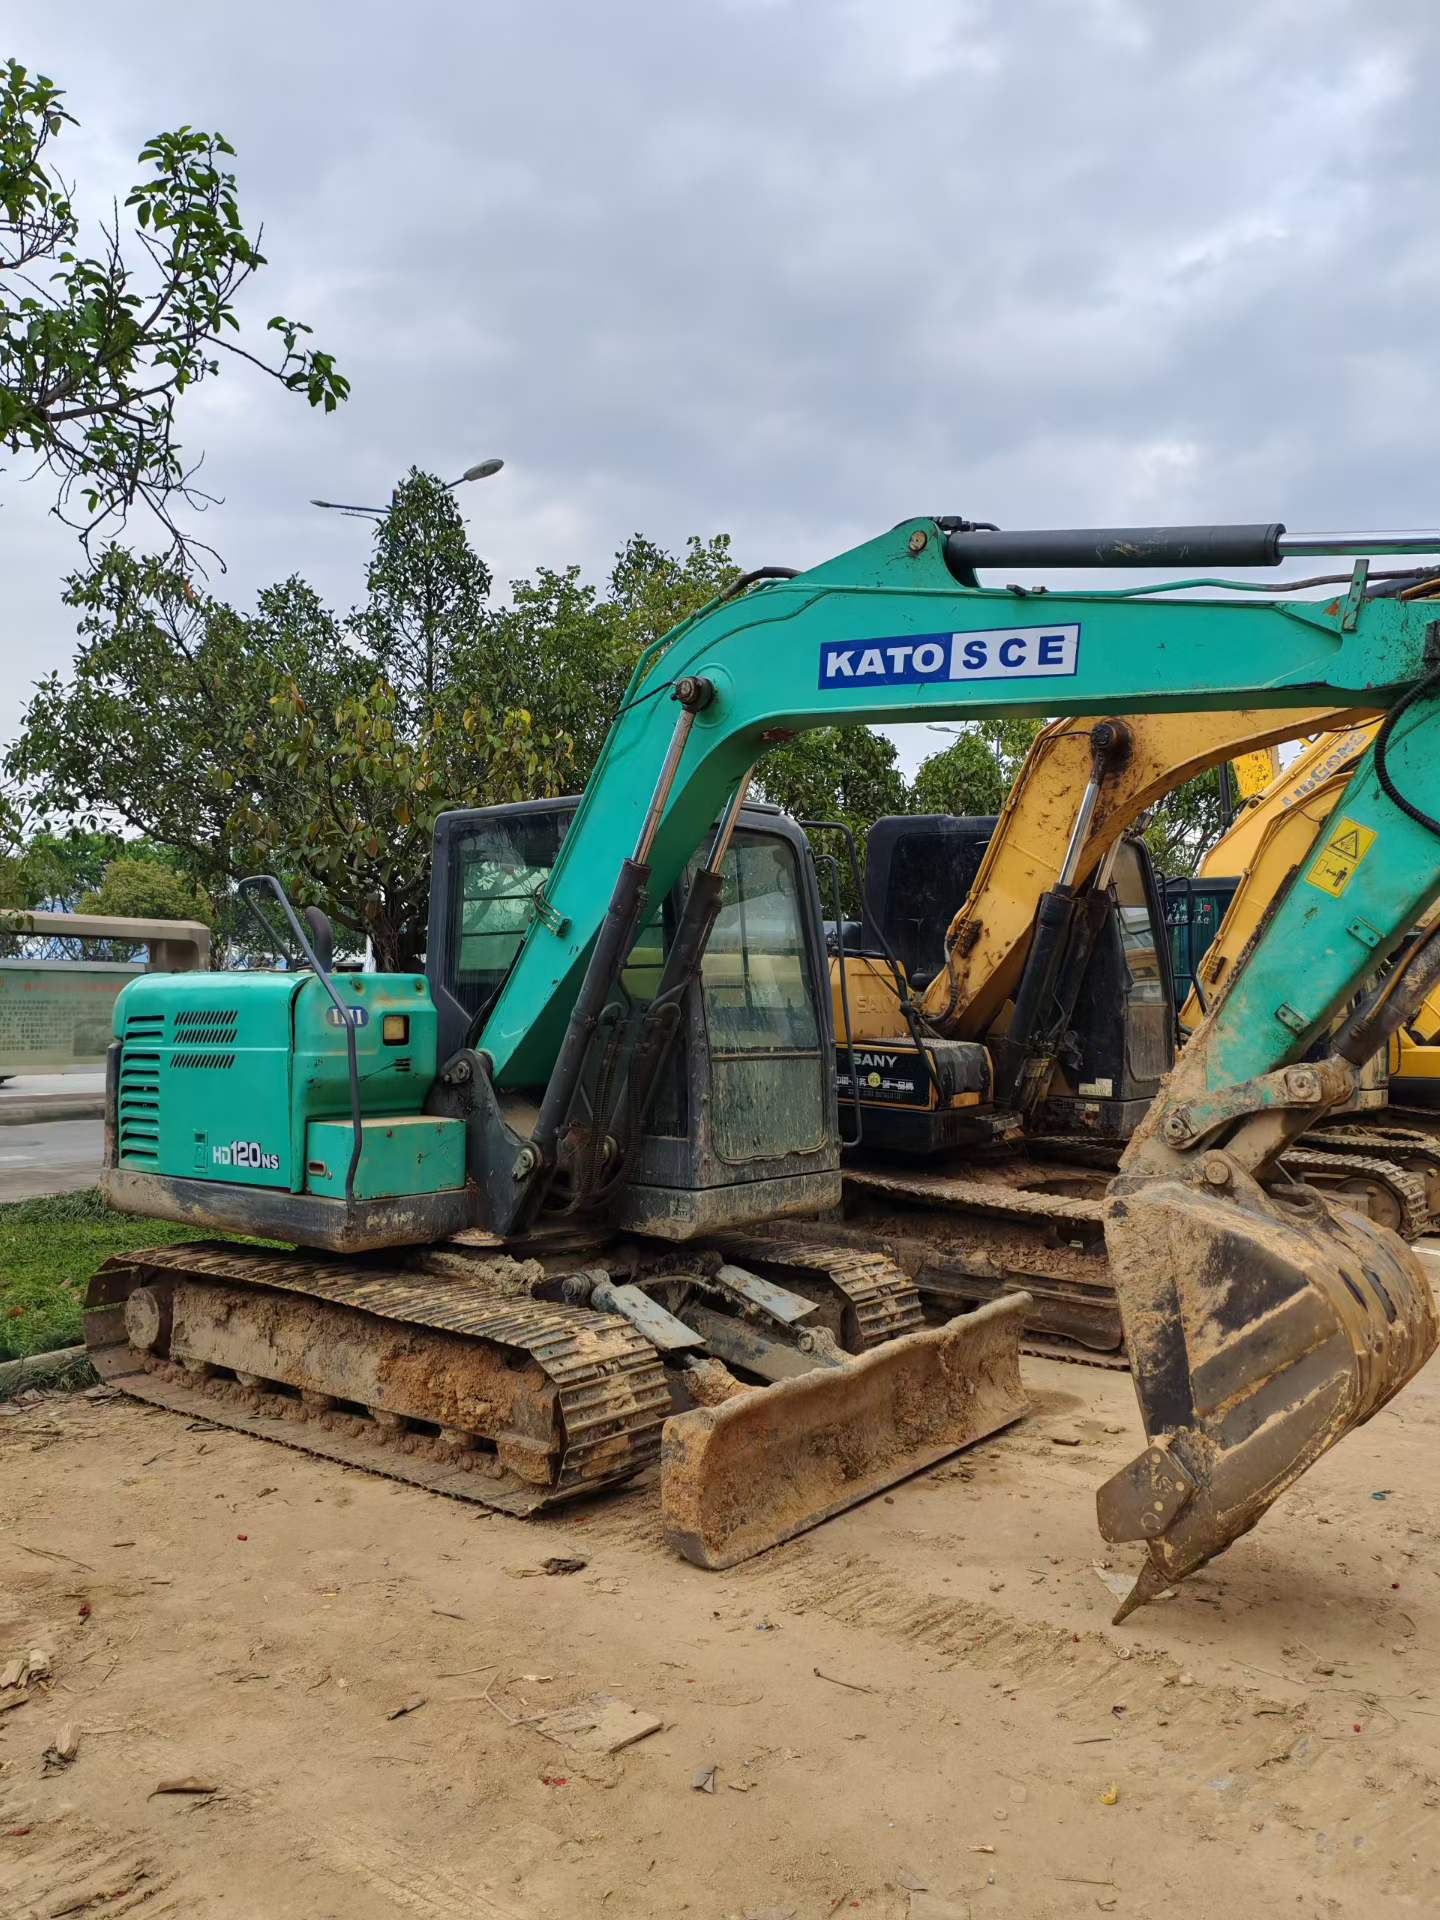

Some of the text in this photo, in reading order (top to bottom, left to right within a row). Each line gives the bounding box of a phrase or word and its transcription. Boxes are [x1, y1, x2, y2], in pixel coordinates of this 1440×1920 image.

[826, 635, 1065, 678] KATO SCE
[853, 1053, 898, 1068] SANY
[212, 1141, 279, 1169] HD120NS
